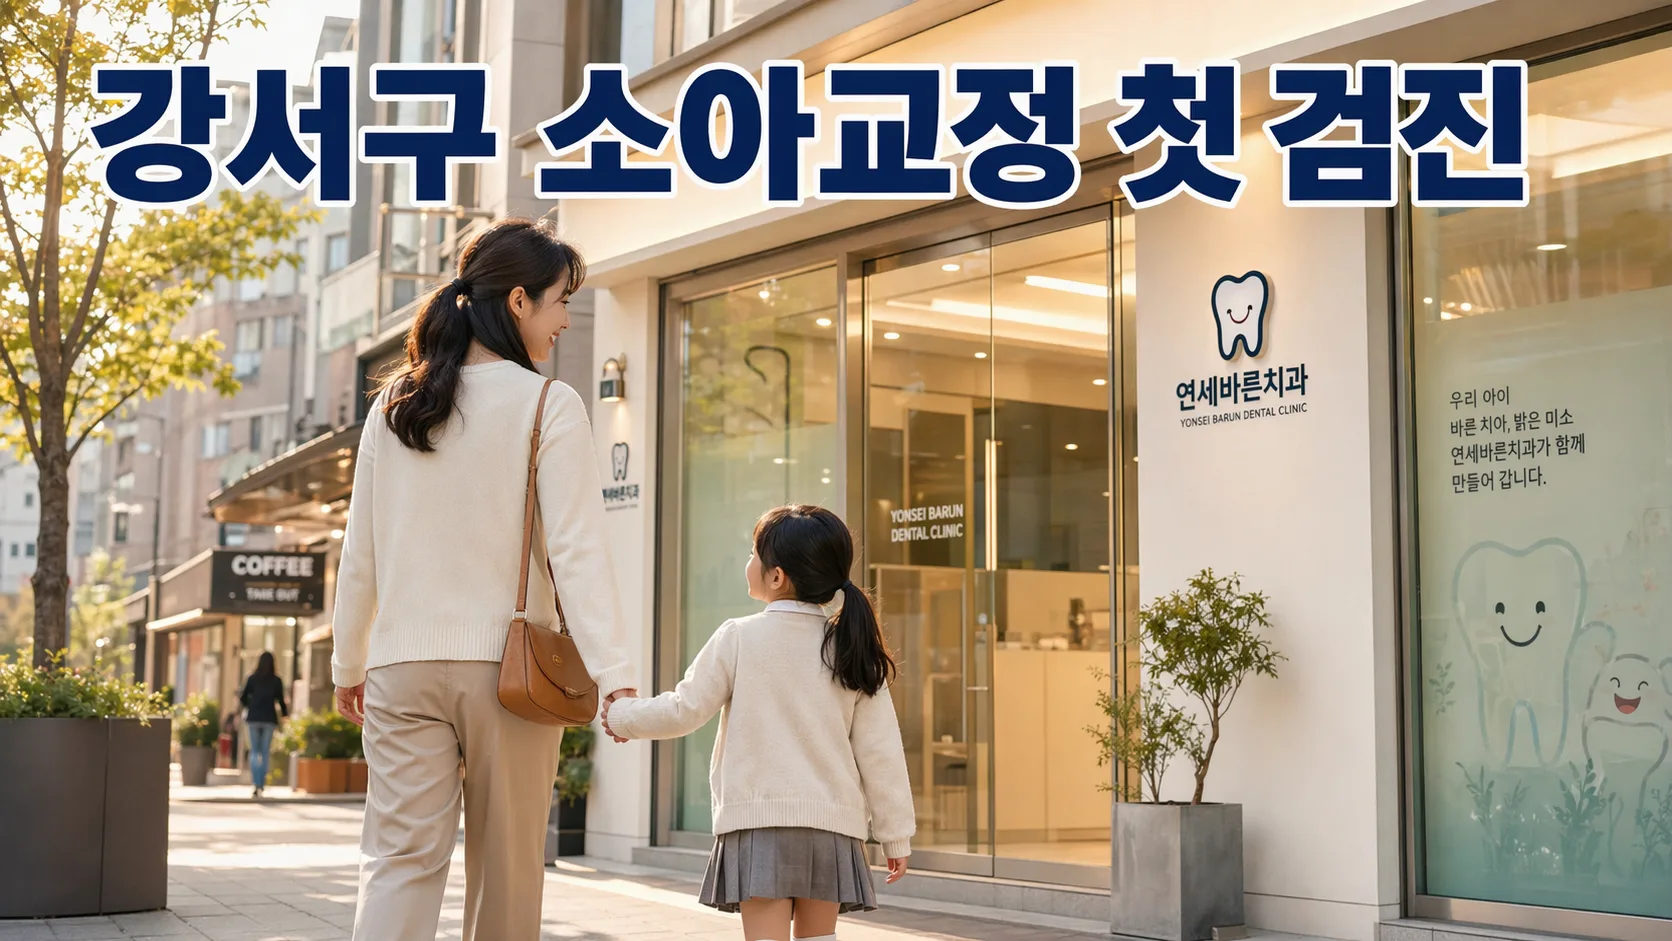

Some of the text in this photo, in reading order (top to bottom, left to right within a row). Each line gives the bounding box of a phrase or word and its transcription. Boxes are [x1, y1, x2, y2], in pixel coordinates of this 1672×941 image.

[1176, 363, 1309, 411] 연세바른치과
[1450, 386, 1510, 410] 우리 아이
[1180, 402, 1308, 428] YONSEI BARUN DENTAL CLINIC
[1450, 408, 1574, 437] 바른 치아, 밝은 미소
[1451, 433, 1586, 466] 연세바른치과가 함께
[1452, 466, 1547, 494] 만들어 갑니다.
[890, 503, 964, 523] YONSEI BARUN
[891, 523, 964, 542] DENTAL CLINIC
[231, 554, 314, 577] COFFEE
